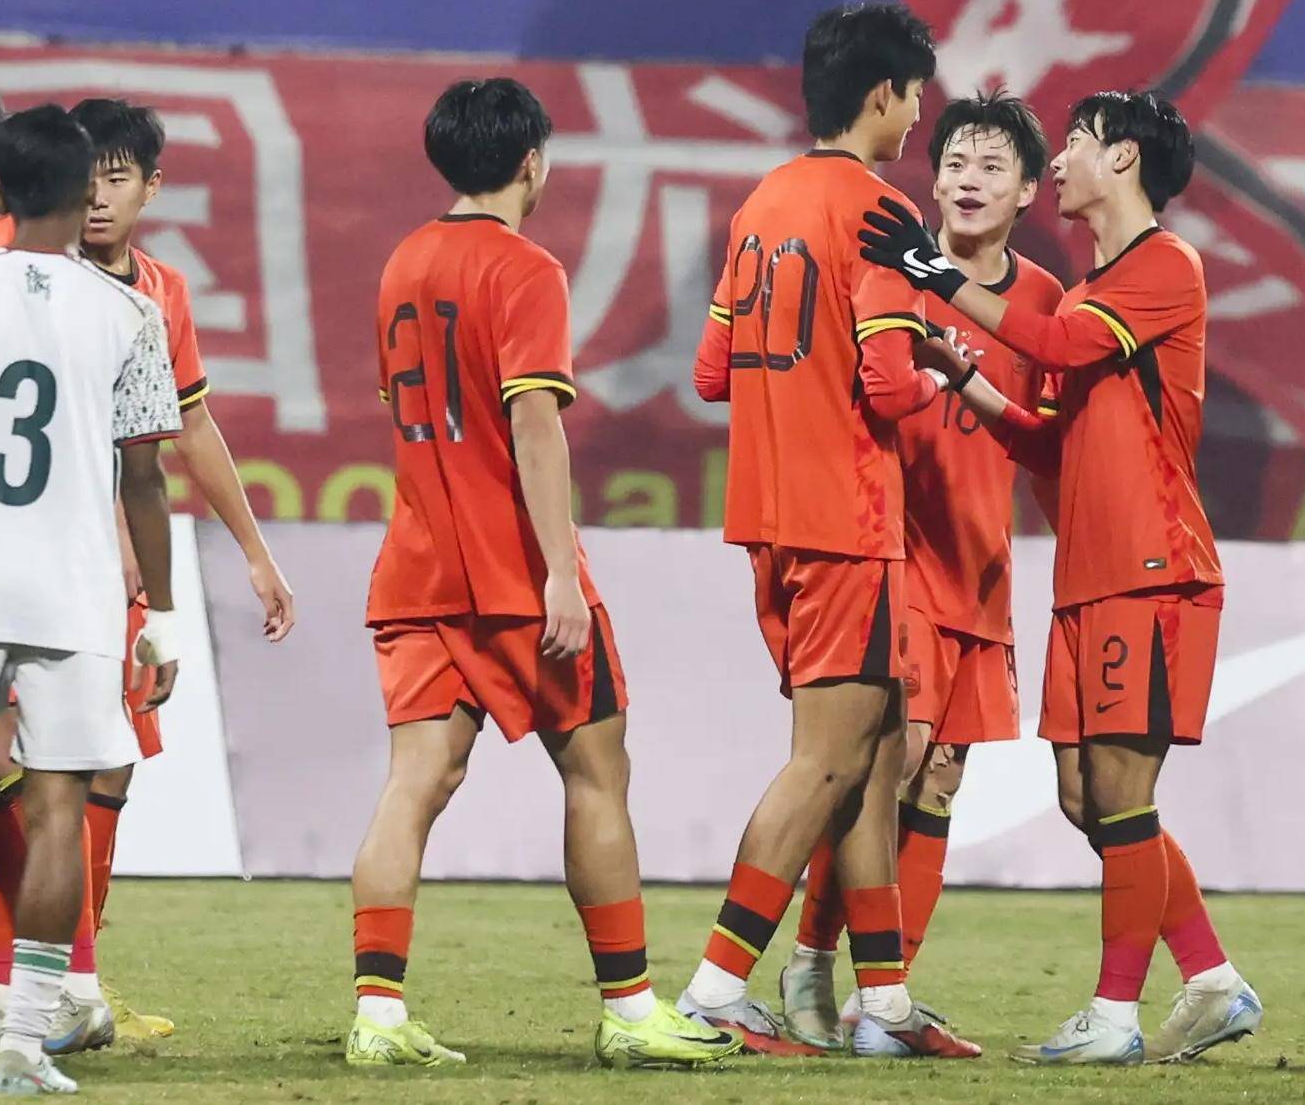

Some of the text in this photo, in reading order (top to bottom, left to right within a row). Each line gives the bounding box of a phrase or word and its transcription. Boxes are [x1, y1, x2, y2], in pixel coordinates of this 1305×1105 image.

[388, 300, 463, 443] 21
[730, 233, 820, 372] 20
[1101, 635, 1129, 691] 2
